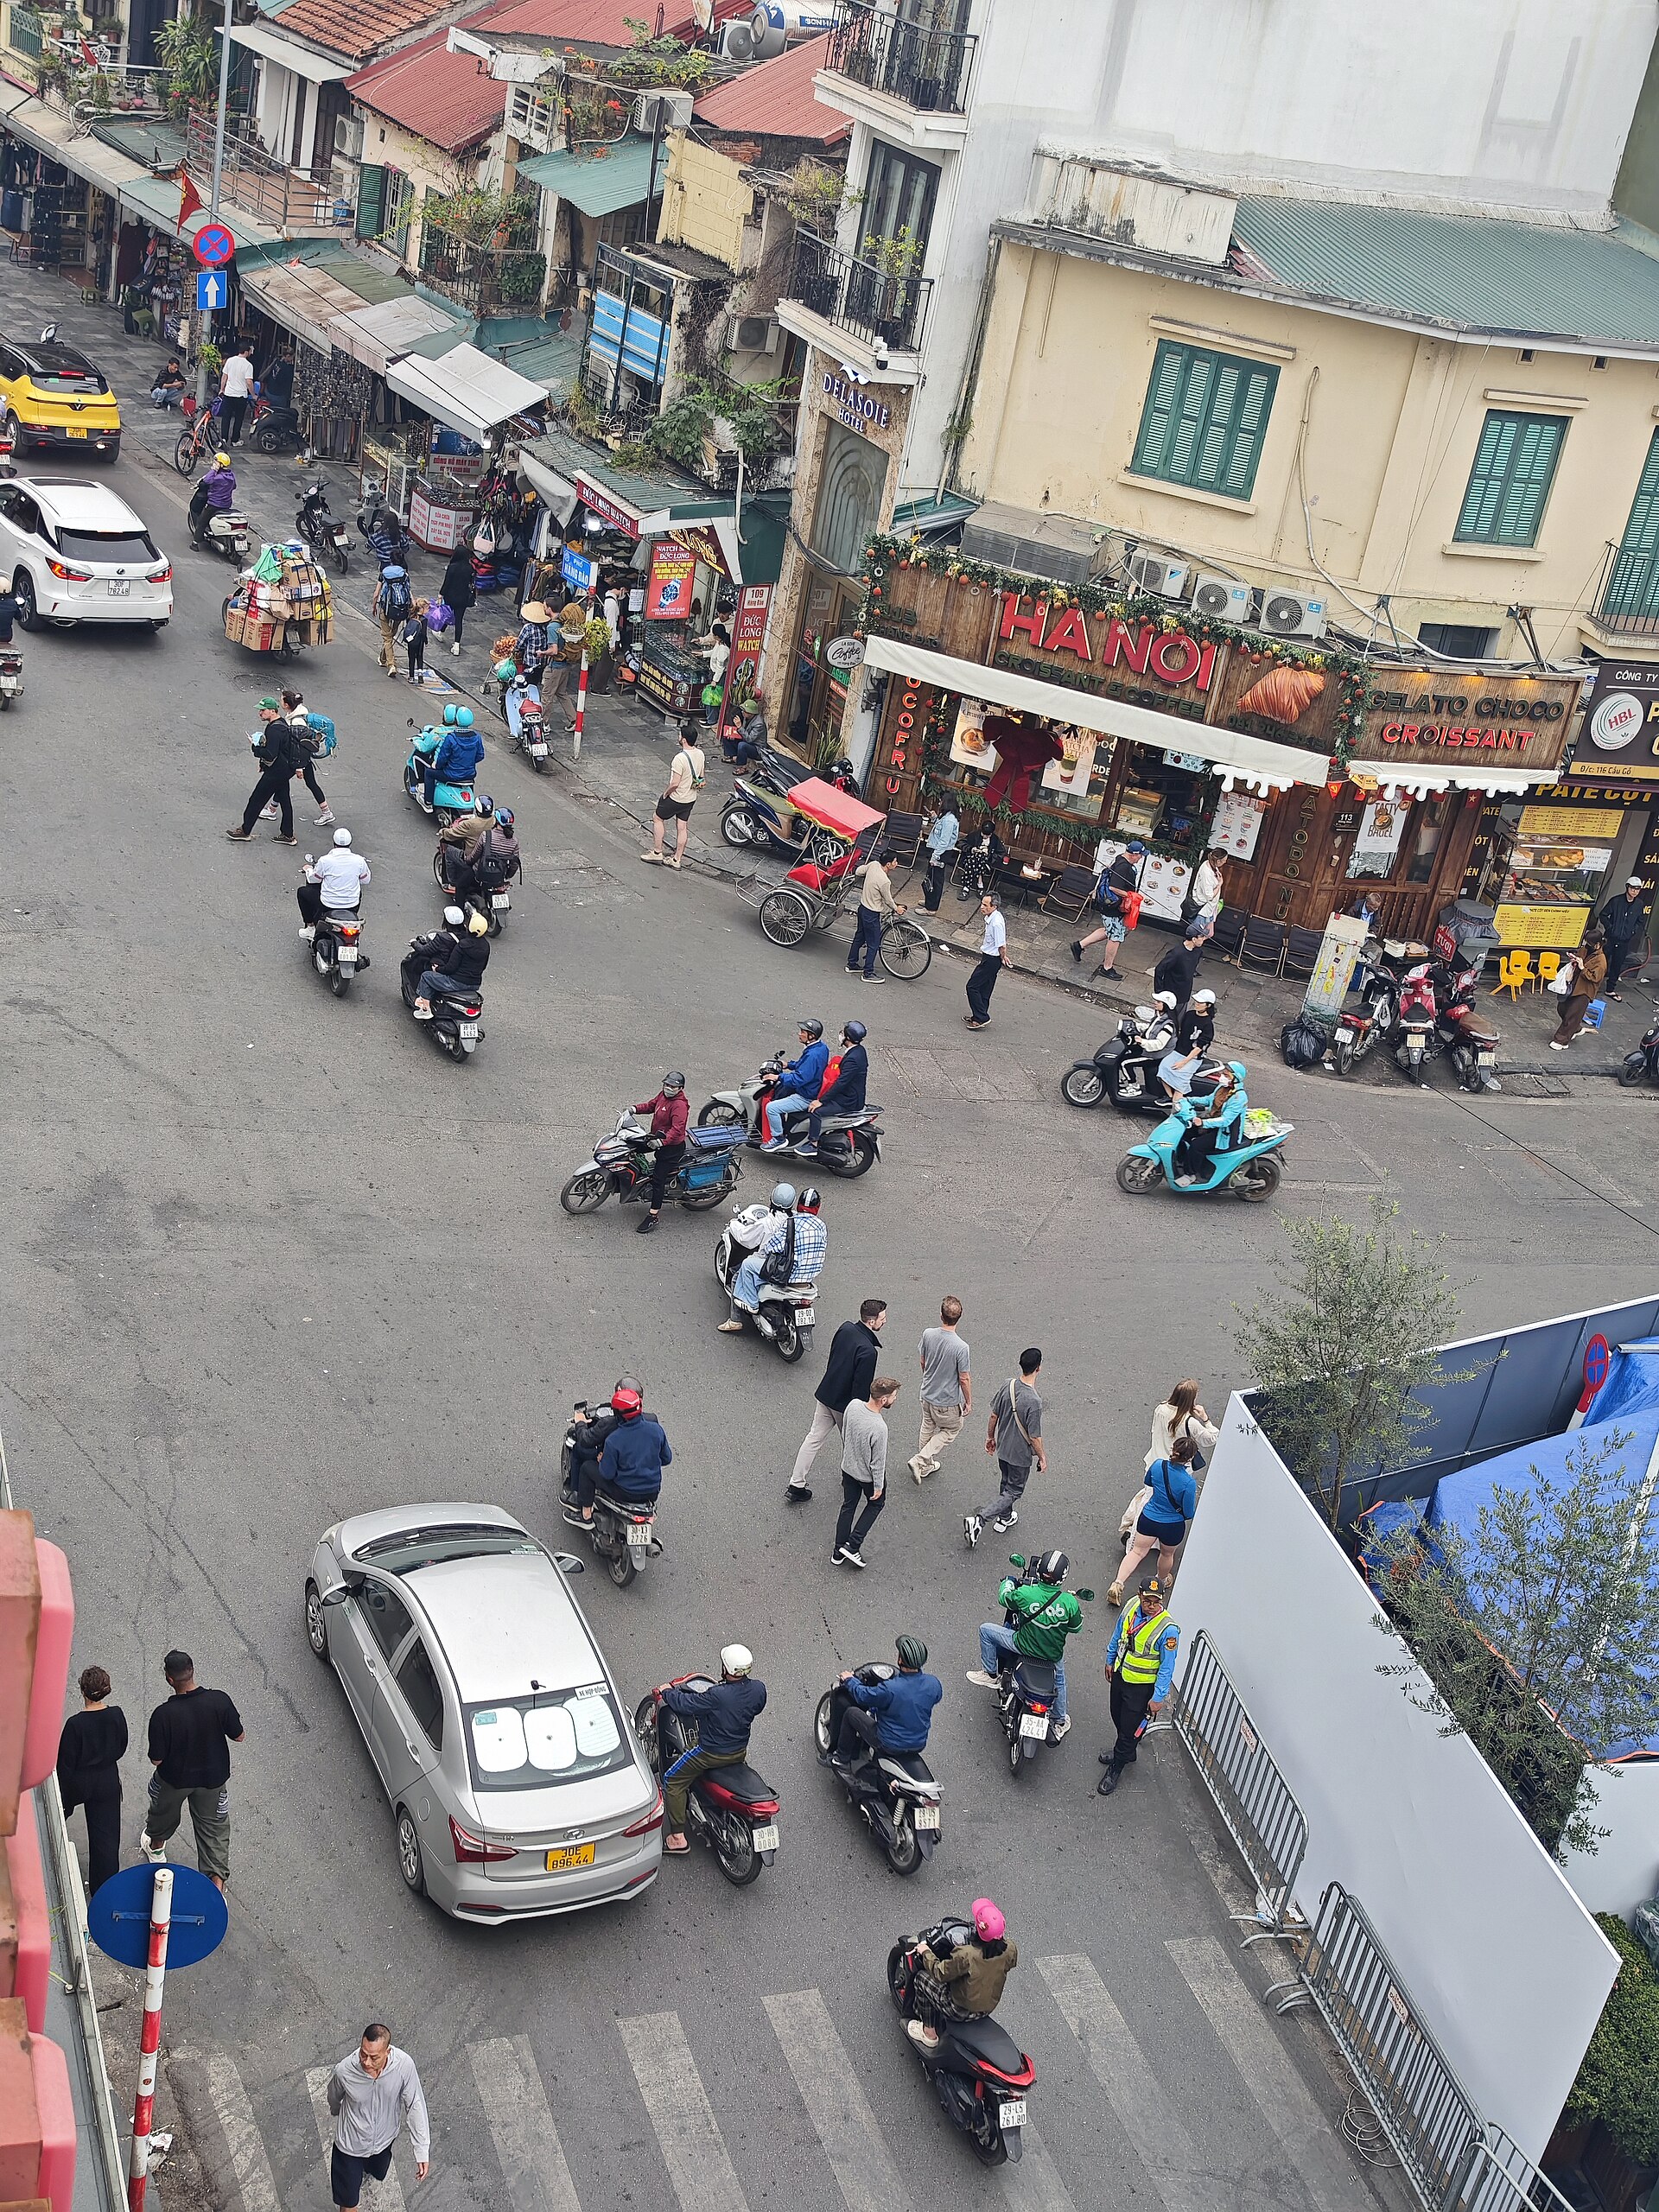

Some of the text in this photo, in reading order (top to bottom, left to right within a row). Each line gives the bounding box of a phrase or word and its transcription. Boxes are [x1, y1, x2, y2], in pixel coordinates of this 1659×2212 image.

[822, 372, 888, 429] DELASOIE
[837, 407, 864, 432] HOTEL
[610, 507, 631, 531] WATCH
[573, 557, 583, 568] PHỐ
[563, 562, 588, 586] HÀNG ĐÀO
[751, 589, 764, 599] 109
[744, 614, 762, 626] ĐỨC
[740, 627, 761, 638] LONG
[738, 639, 760, 652] WATCH
[1615, 670, 1658, 683] CÔNG TY
[995, 650, 1206, 720] CROISSANT & COFFEE
[1370, 690, 1565, 721] GELATO CHOCO
[1608, 709, 1634, 729] HBL
[1382, 722, 1535, 751] CROISSANT
[1482, 806, 1501, 817] ATE
[1026, 1717, 1043, 1728] 35-AA
[561, 1847, 582, 1858] 30E
[551, 1855, 589, 1869] 896.44
